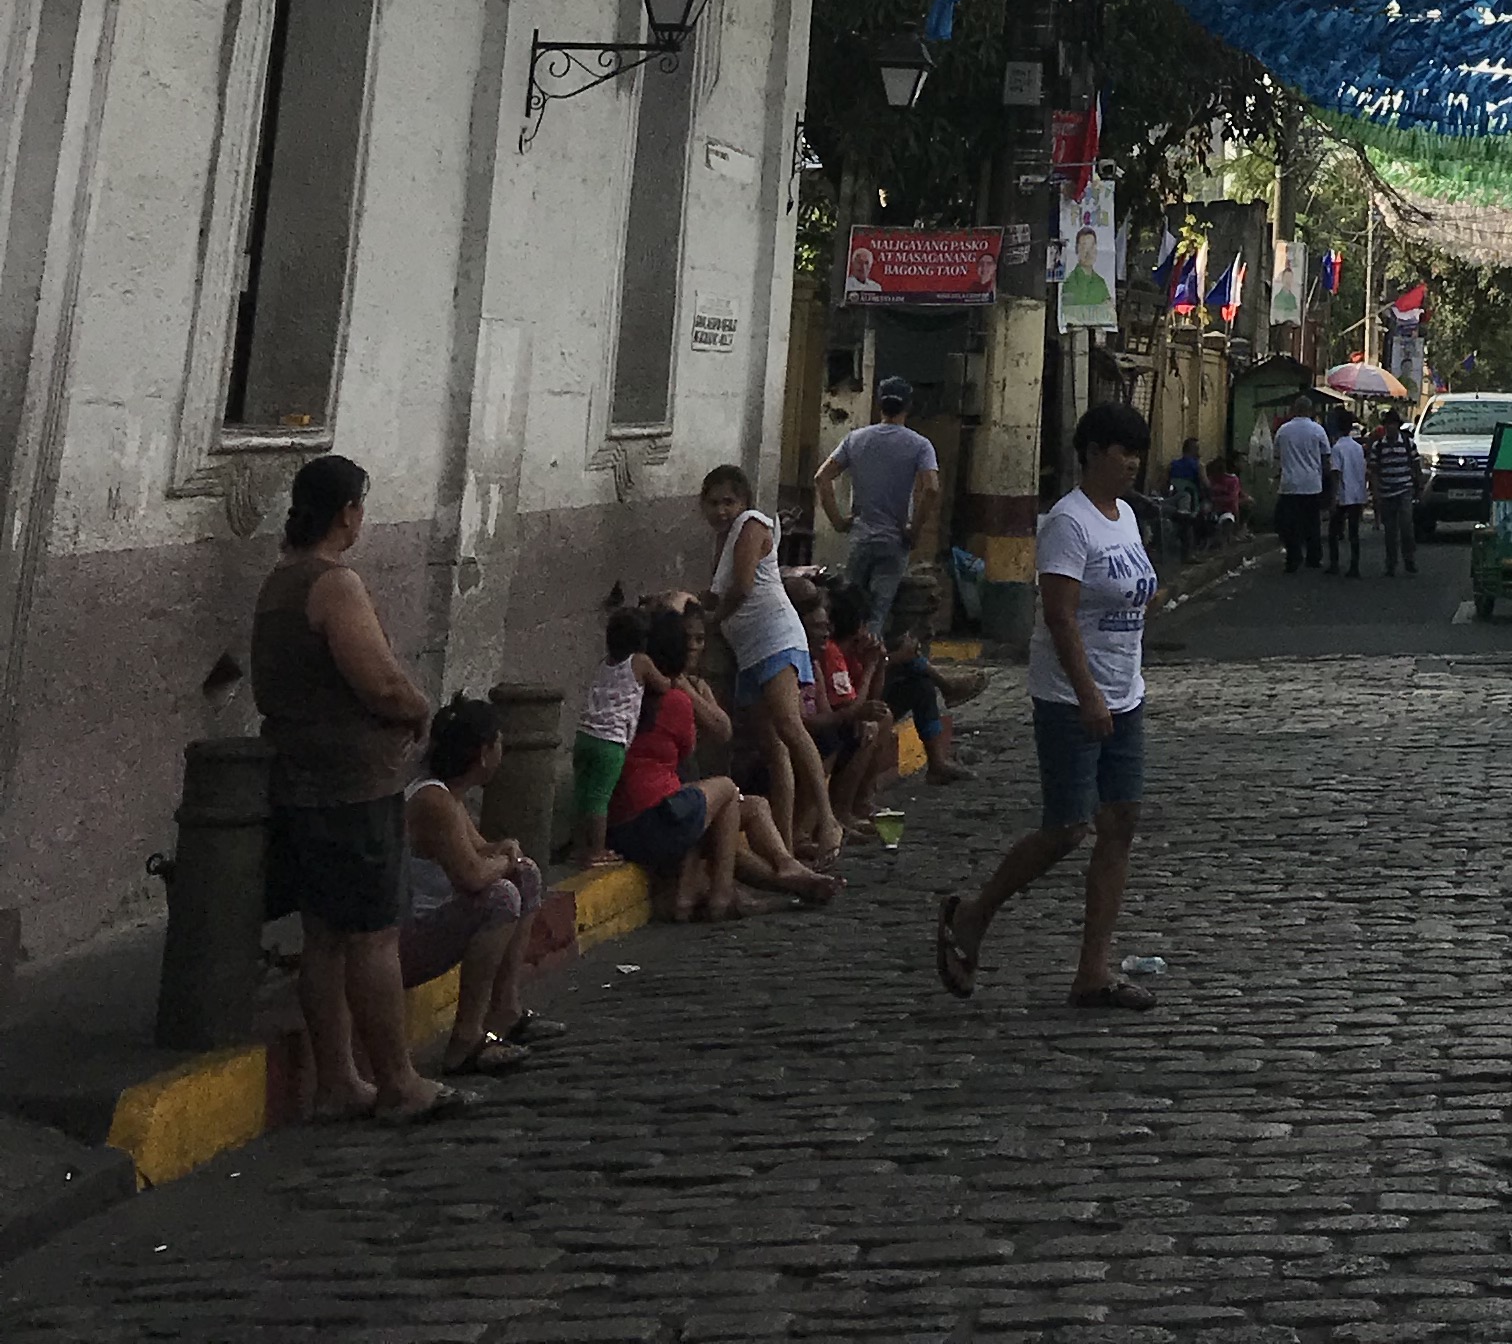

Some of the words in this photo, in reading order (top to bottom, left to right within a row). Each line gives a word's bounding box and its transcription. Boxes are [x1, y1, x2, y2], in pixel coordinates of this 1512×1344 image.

[870, 239, 949, 252] MALIGAYANG
[950, 240, 989, 252] PASKO
[878, 252, 894, 262] AT
[895, 252, 977, 263] MASAGANANG
[884, 264, 934, 275] BAGONG
[936, 265, 968, 276] TAON
[1107, 555, 1132, 579] ANG
